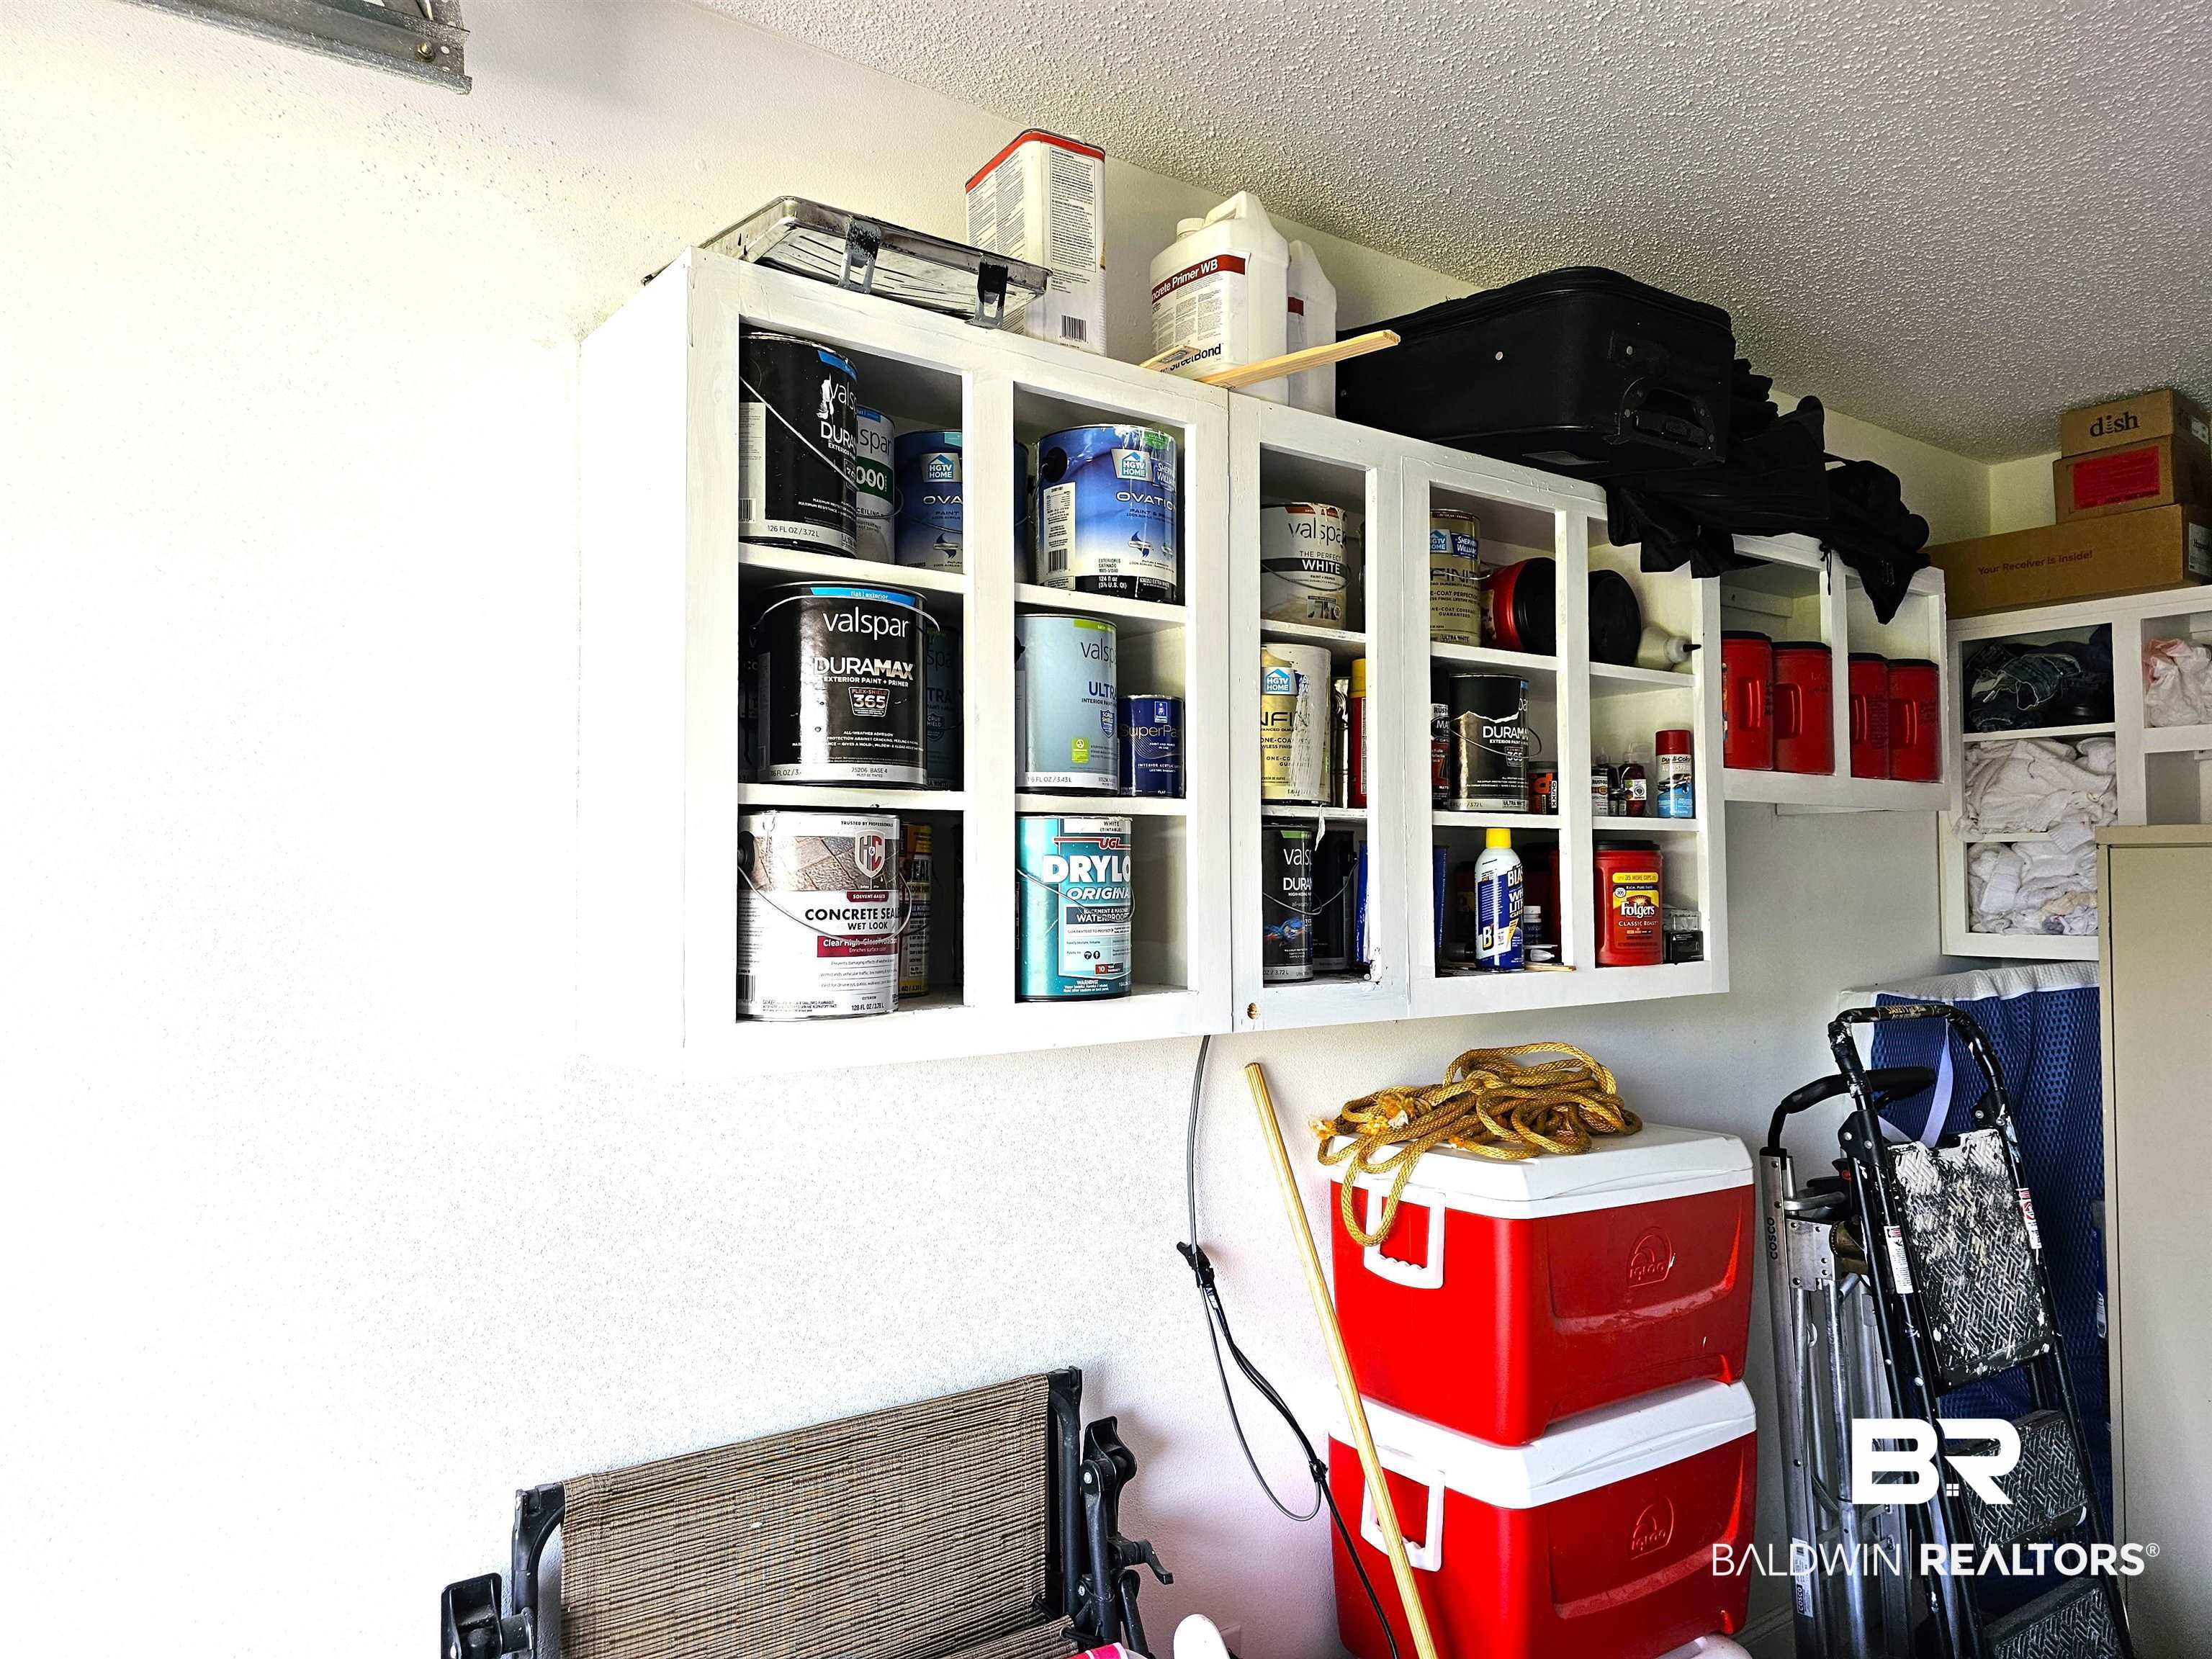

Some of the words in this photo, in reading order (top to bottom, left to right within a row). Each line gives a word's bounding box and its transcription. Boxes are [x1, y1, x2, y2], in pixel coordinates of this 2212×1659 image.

[1172, 268, 1200, 288] Primer
[1200, 258, 1218, 274] WB
[2089, 411, 2141, 438] dish
[1123, 461, 1145, 469] HGTV
[1123, 469, 1146, 477] HOME
[1316, 552, 1341, 562] PERFECT
[1977, 565, 2000, 575] Your
[2002, 559, 2046, 571] Receiver
[2059, 550, 2093, 563] inside!
[1301, 559, 1341, 575] WHITE
[822, 606, 909, 641] valspar
[1080, 638, 1116, 668] valsp
[814, 657, 914, 680] DURAMAX
[853, 695, 886, 709] 365
[1100, 837, 1121, 850] UGL
[1283, 877, 1313, 891] DURA
[804, 908, 878, 921] CONCRETE
[1620, 901, 1655, 919] Folgers
[868, 921, 888, 930] LOOK
[1767, 1217, 1778, 1260] COSCO
